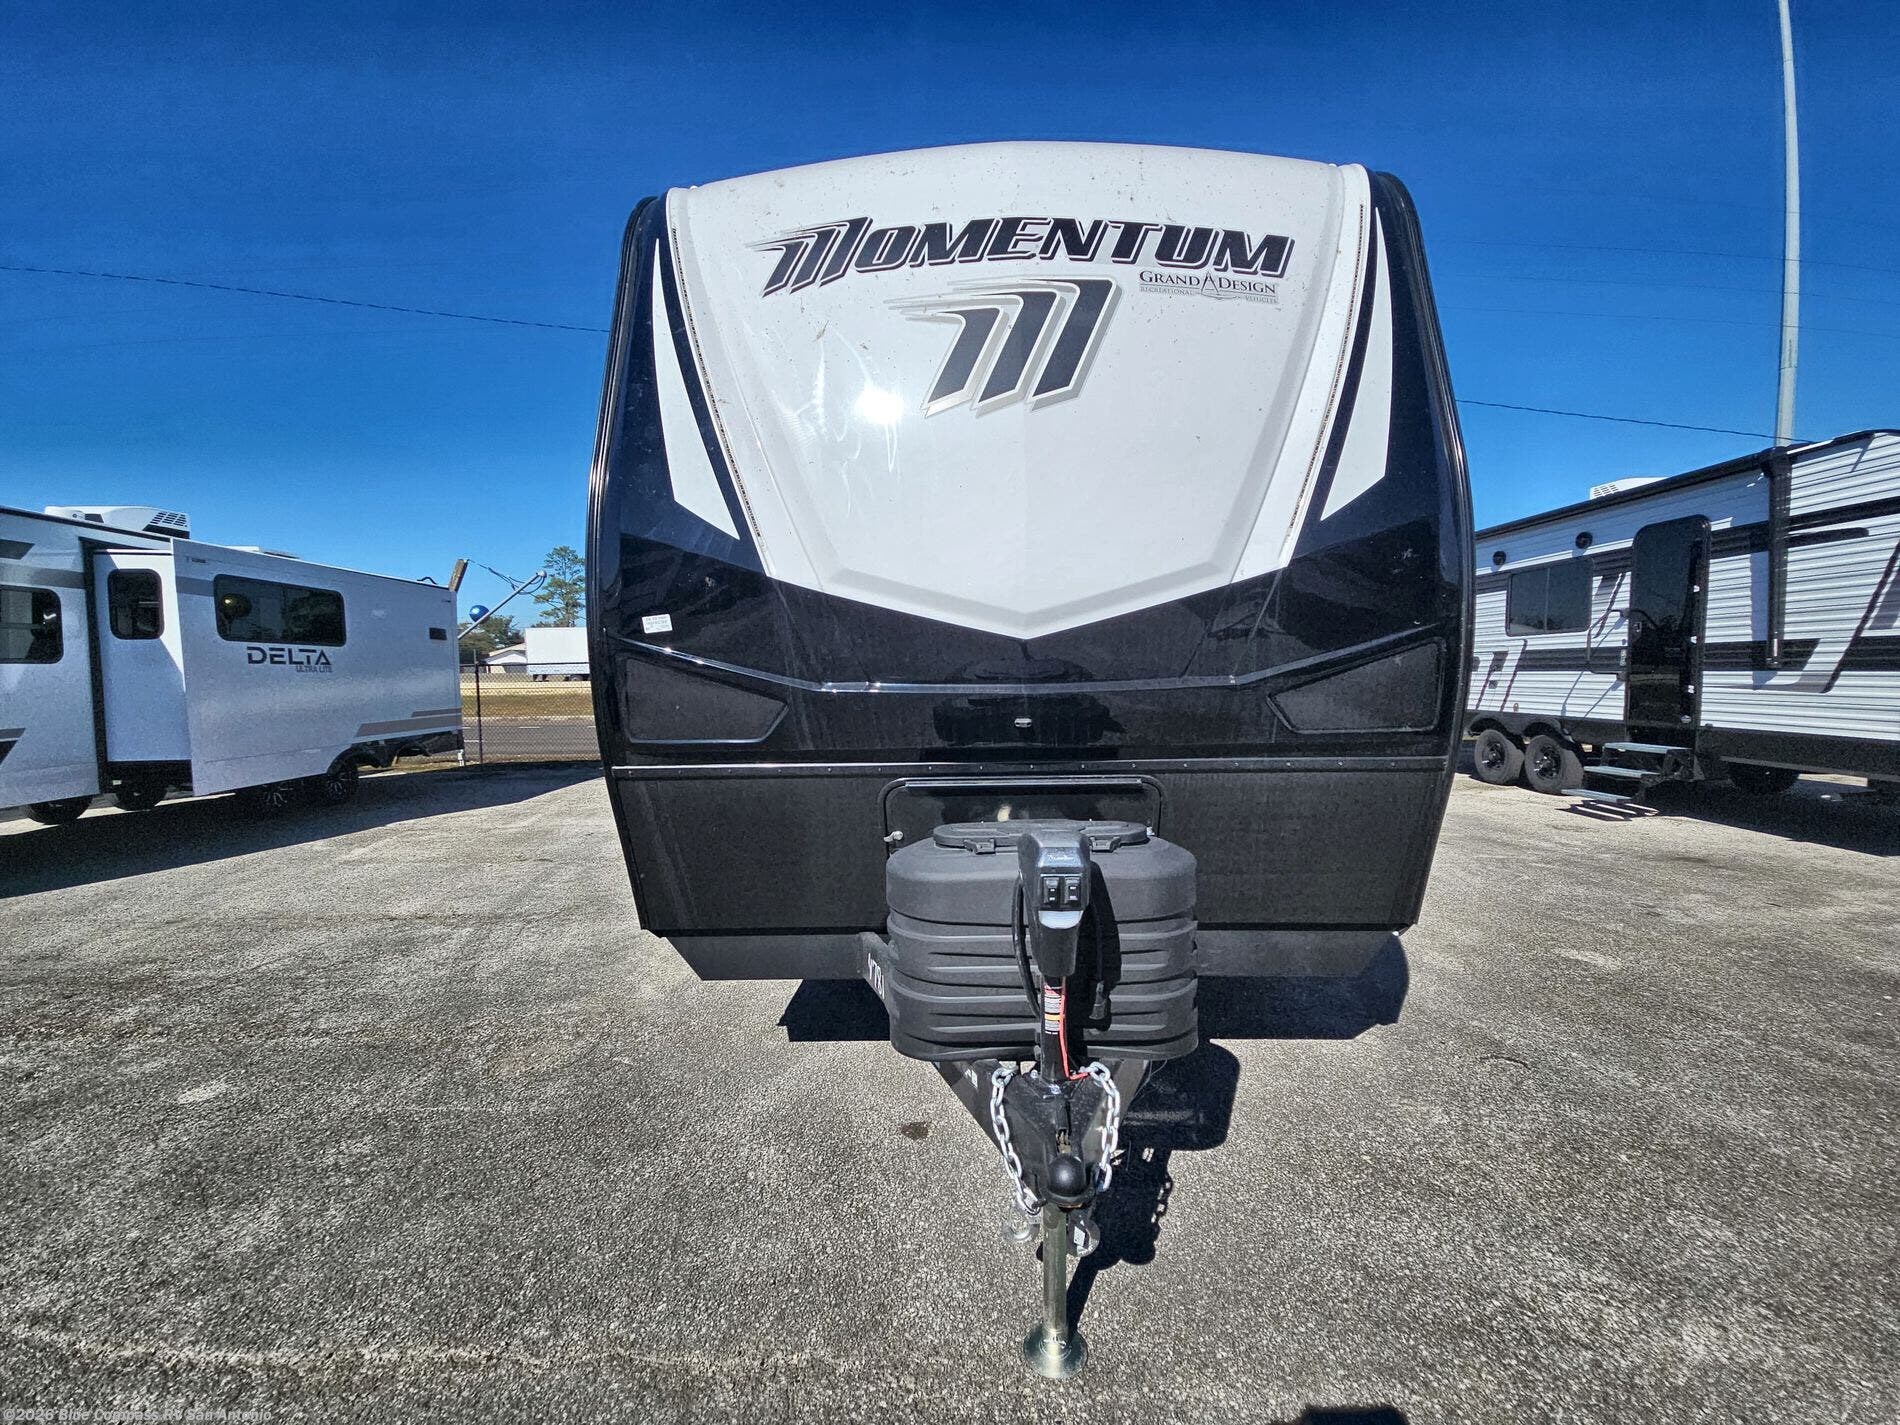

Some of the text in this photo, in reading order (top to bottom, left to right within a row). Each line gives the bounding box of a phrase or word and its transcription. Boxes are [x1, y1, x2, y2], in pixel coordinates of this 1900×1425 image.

[745, 216, 1295, 298] MOMENTUM
[1139, 270, 1276, 294] GRAND DESIGN
[247, 646, 332, 665] DELTA
